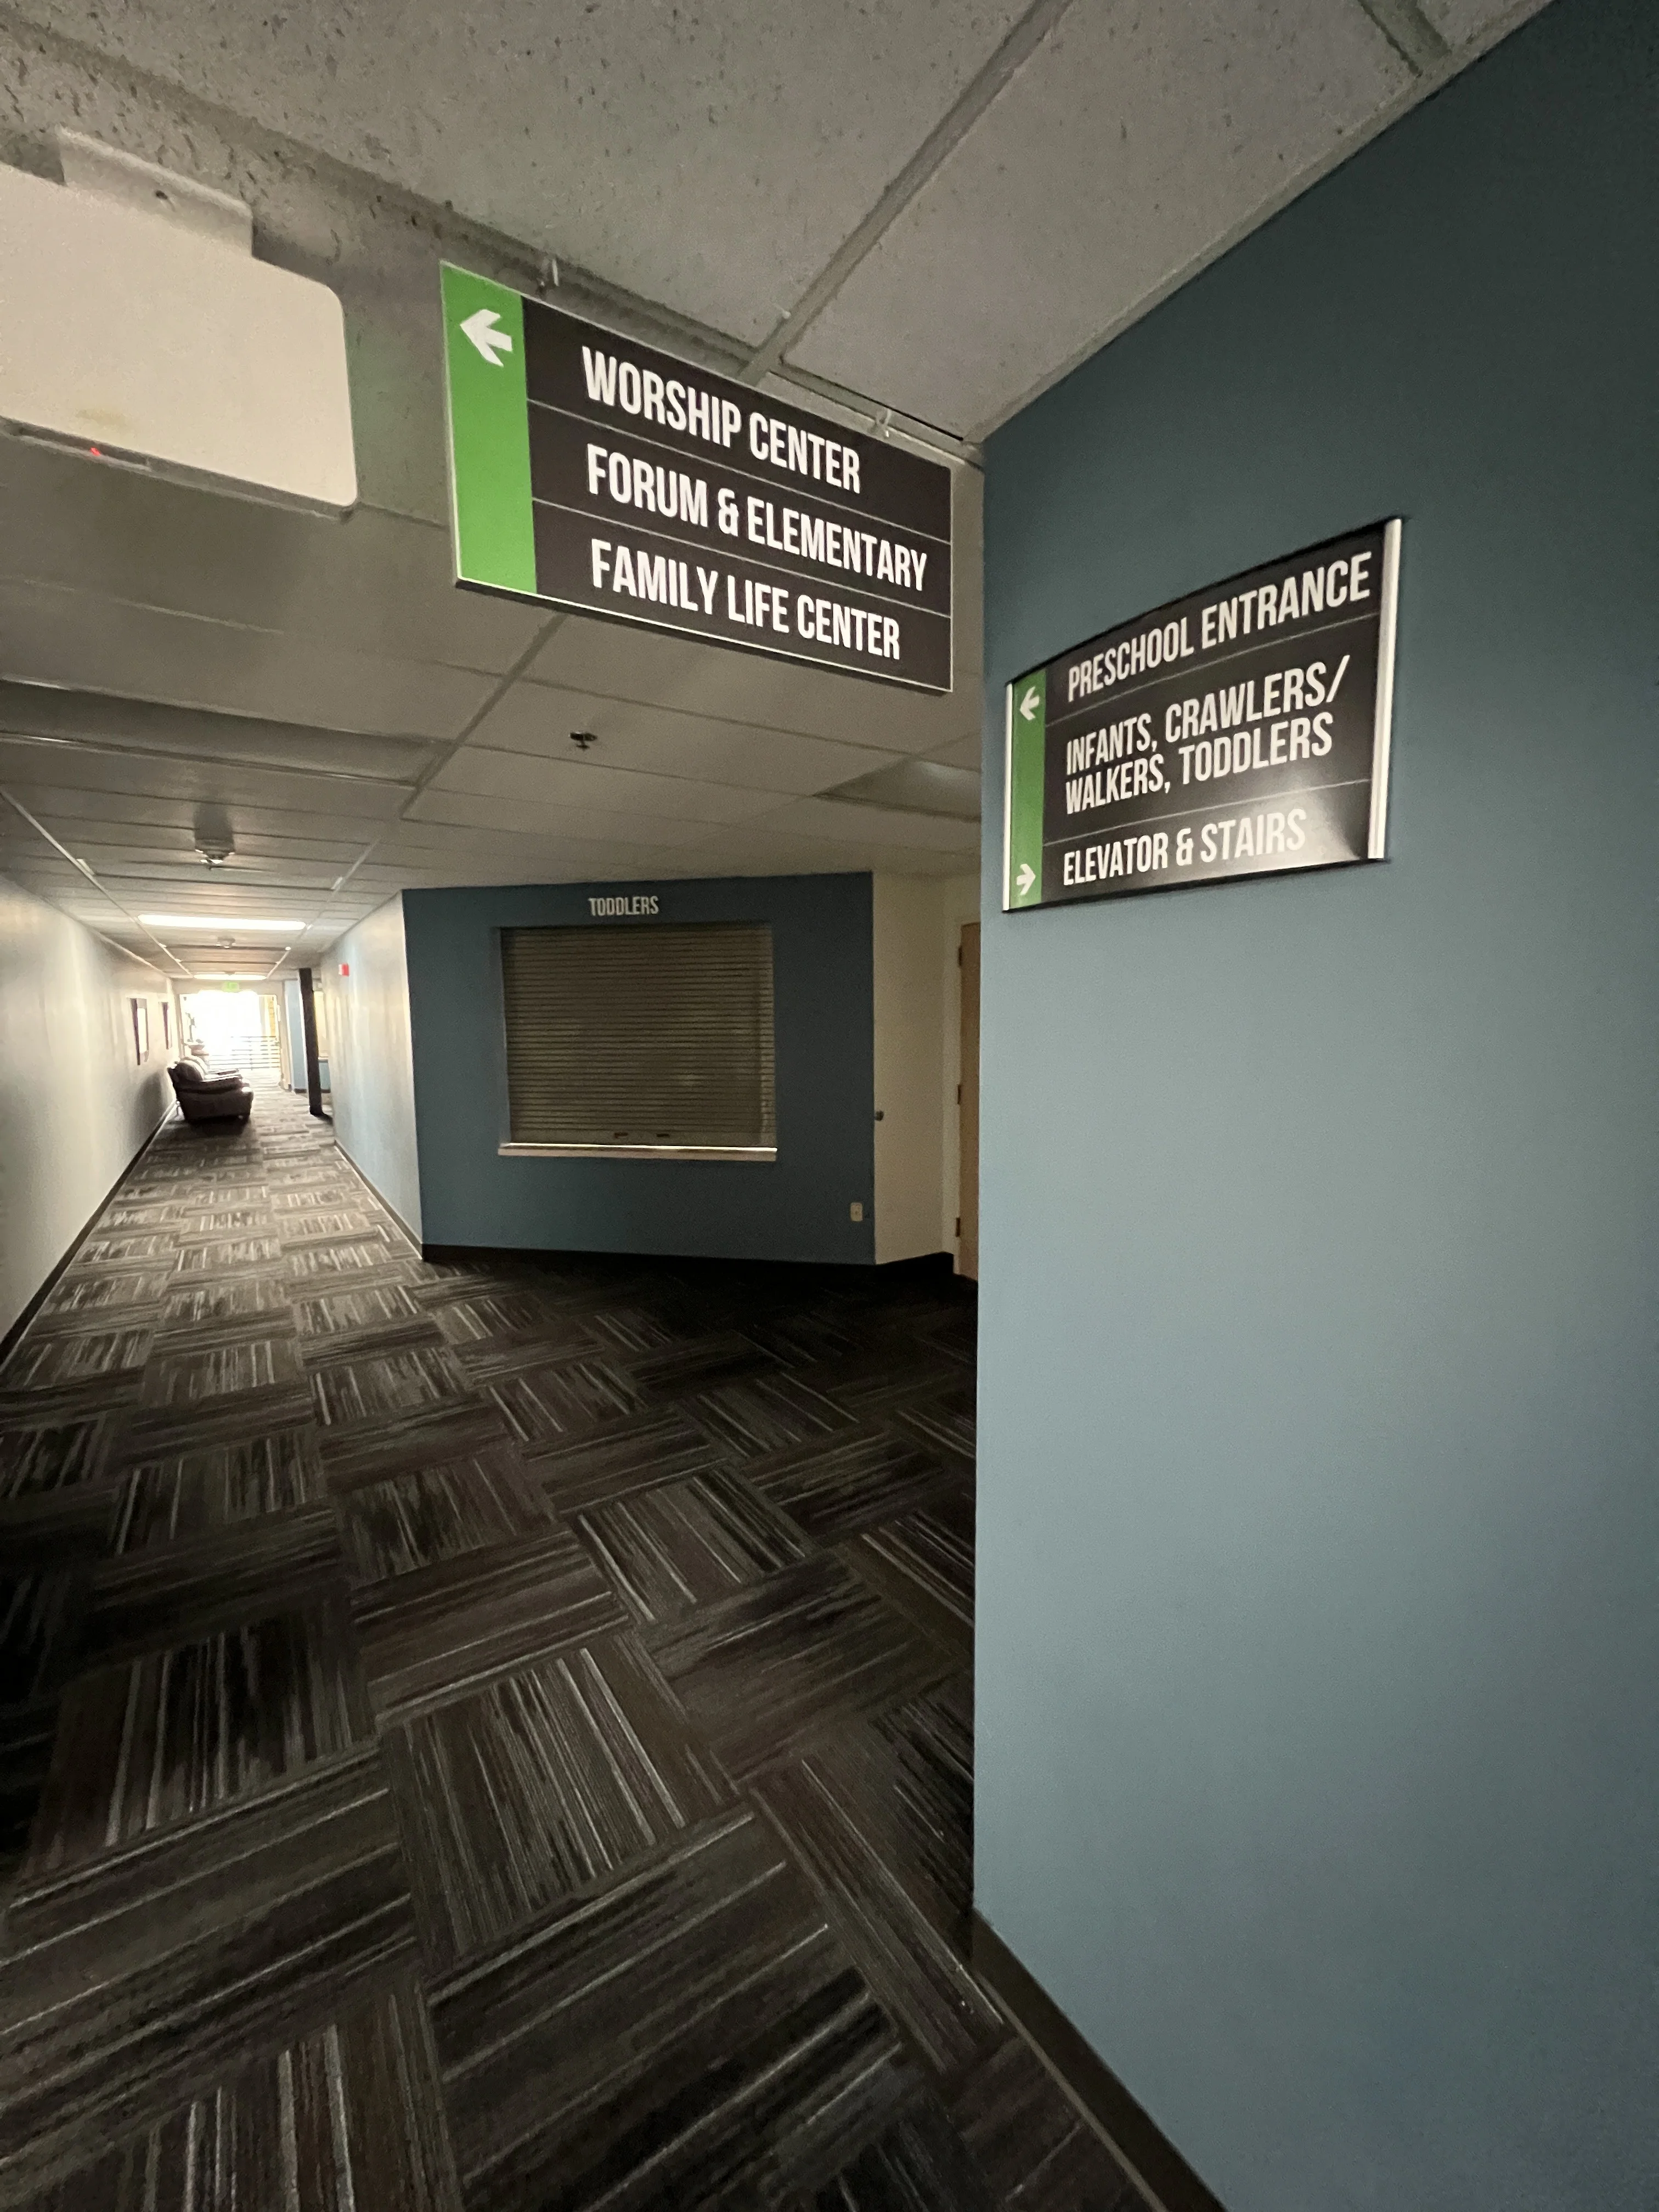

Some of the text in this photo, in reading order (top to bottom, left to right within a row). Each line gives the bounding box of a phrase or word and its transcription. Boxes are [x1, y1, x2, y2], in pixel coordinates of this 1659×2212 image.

[582, 346, 860, 493] WORSHIP CENTER
[586, 443, 927, 591] FORUM & ELEMENTARY
[591, 539, 900, 660] FAMILY LIFE CENTER
[1068, 551, 1372, 703] PRESCHOOL ENTRANCE
[1065, 712, 1333, 814] WALKERS, TODDLERS
[1066, 654, 1350, 775] INFANTS, CRAWLERS/
[588, 896, 658, 916] TODDLERS
[1063, 809, 1307, 886] ELEVATOR & STAIRS
